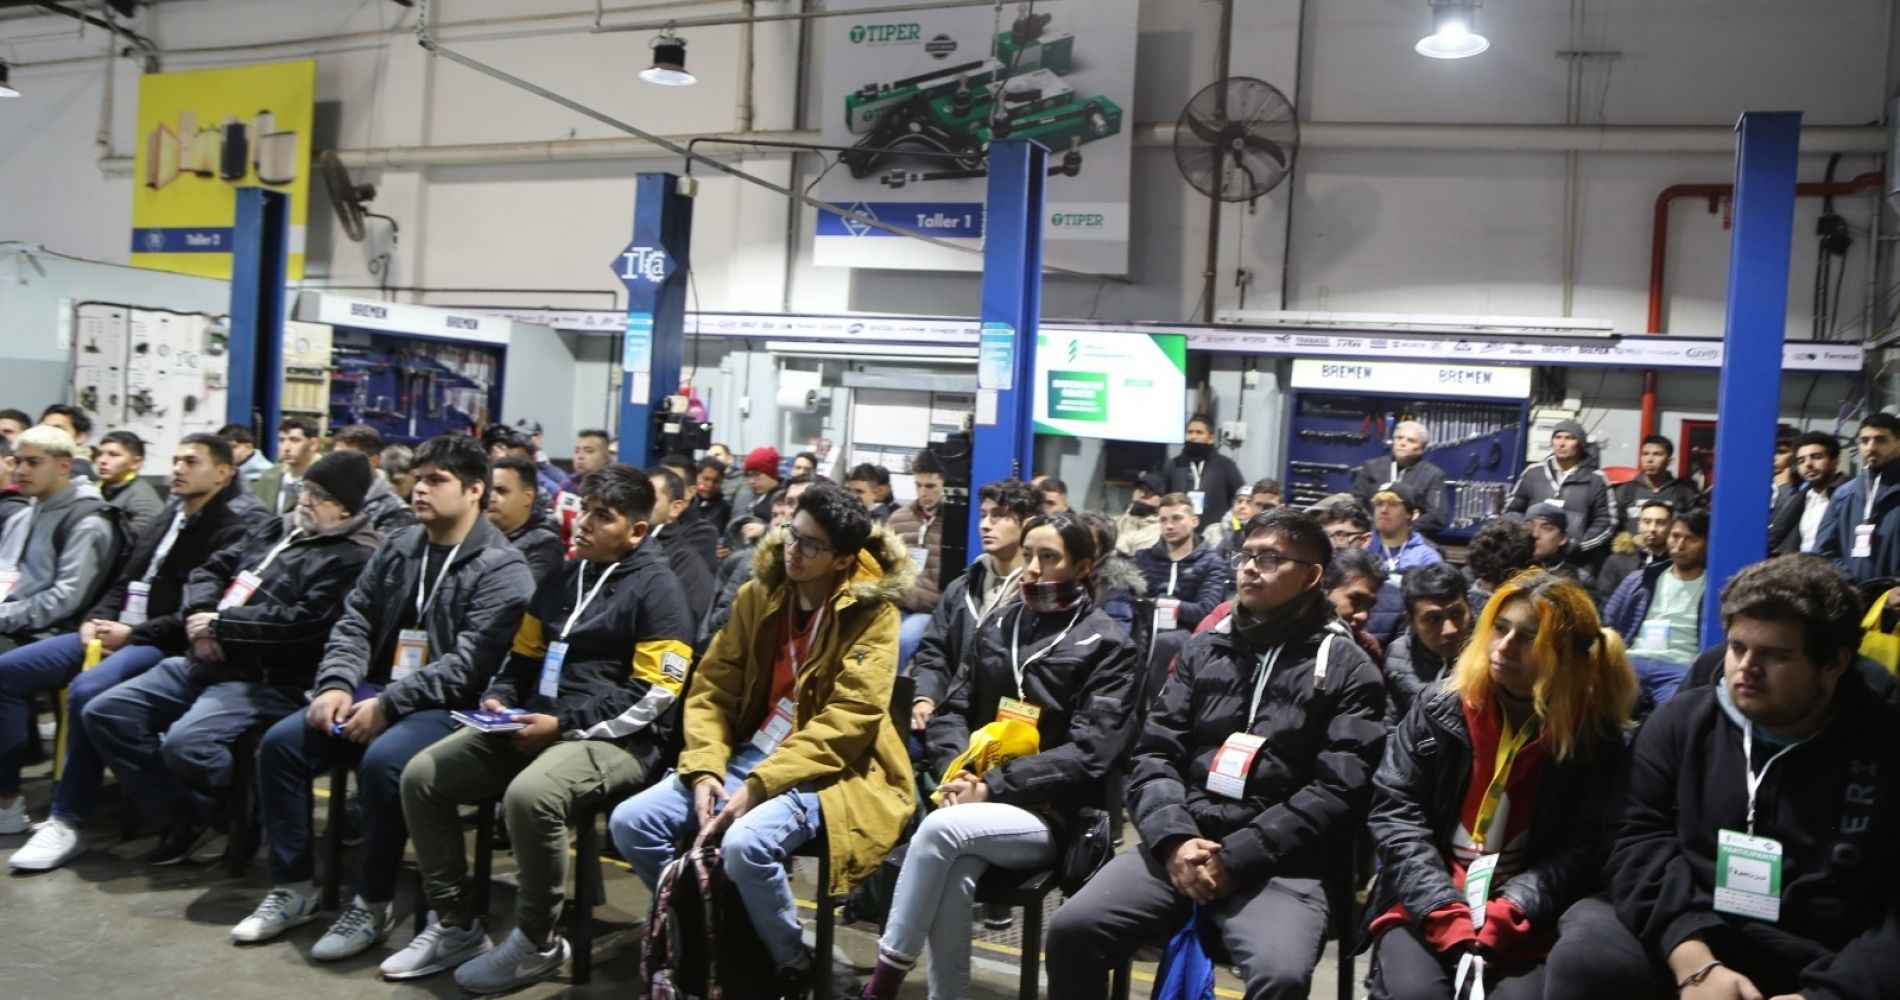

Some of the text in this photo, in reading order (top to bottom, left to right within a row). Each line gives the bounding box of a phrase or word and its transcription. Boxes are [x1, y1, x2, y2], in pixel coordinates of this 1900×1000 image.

[867, 23, 920, 42] TIPER
[917, 213, 972, 228] Taller 1
[1065, 214, 1104, 226] TIPER
[351, 302, 388, 319] BREMEN
[446, 315, 479, 330] BREMEN
[1321, 364, 1373, 378] BREMEN
[1439, 369, 1493, 384] BREMEN
